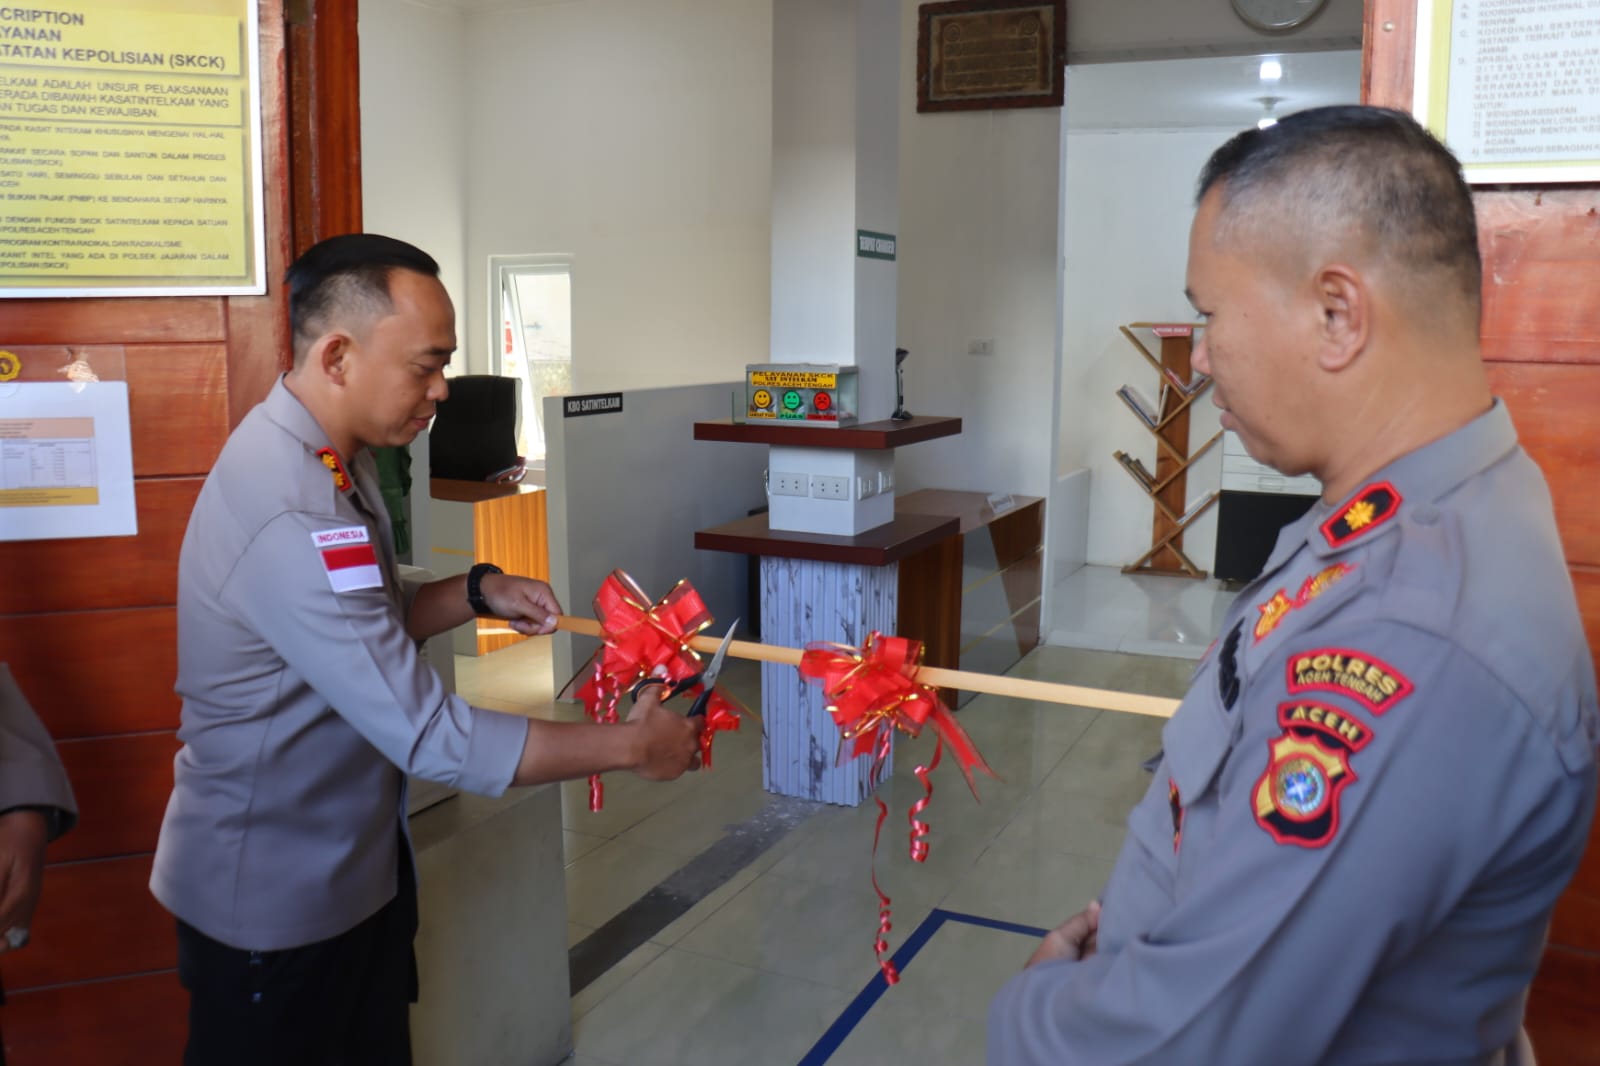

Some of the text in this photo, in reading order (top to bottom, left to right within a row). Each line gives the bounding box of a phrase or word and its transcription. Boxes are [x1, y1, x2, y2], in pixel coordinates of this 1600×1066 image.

[0, 7, 84, 26] CRIPTION
[62, 48, 164, 65] KEPOLISIAN
[169, 54, 225, 71] (SKCK)
[42, 79, 91, 90] ADALAH
[97, 81, 139, 93] UNSUR
[144, 83, 229, 96] PELAKSANAAN
[16, 103, 58, 114] TUGAS
[61, 104, 87, 116] DAN
[41, 91, 96, 103] DIBAWAH
[99, 94, 195, 108] KASATINTELKAM
[198, 98, 229, 109] YANG
[318, 529, 364, 544] INDONESIA
[1296, 654, 1399, 696] POLRES
[1297, 670, 1385, 704] ACEH TENGAH
[1291, 704, 1359, 742] ACEH
